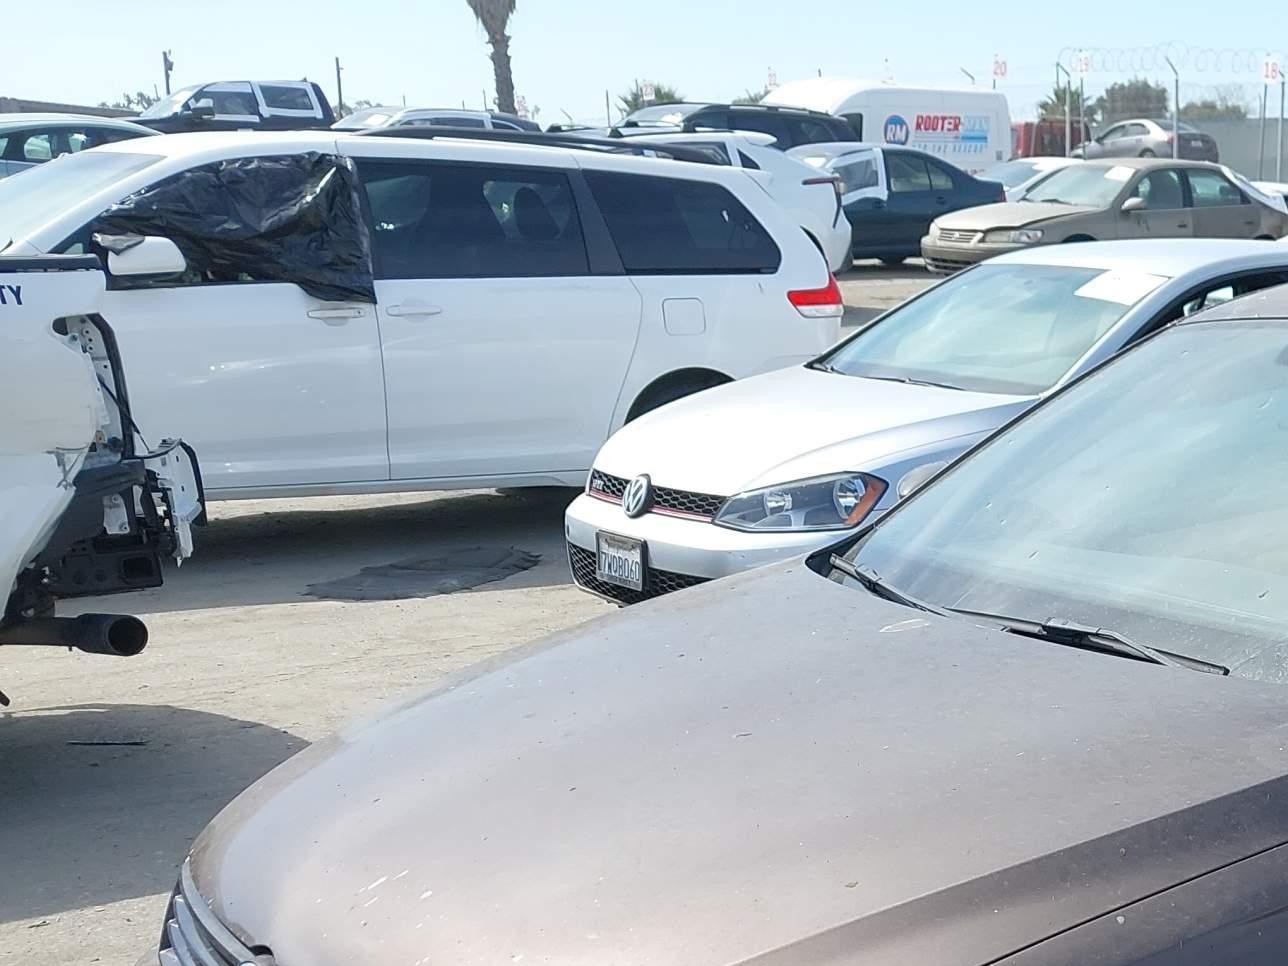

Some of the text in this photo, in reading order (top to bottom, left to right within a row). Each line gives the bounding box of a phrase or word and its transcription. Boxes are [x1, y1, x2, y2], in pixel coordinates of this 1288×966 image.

[992, 60, 1007, 77] 20
[1264, 61, 1278, 79] 18
[886, 124, 907, 142] RM
